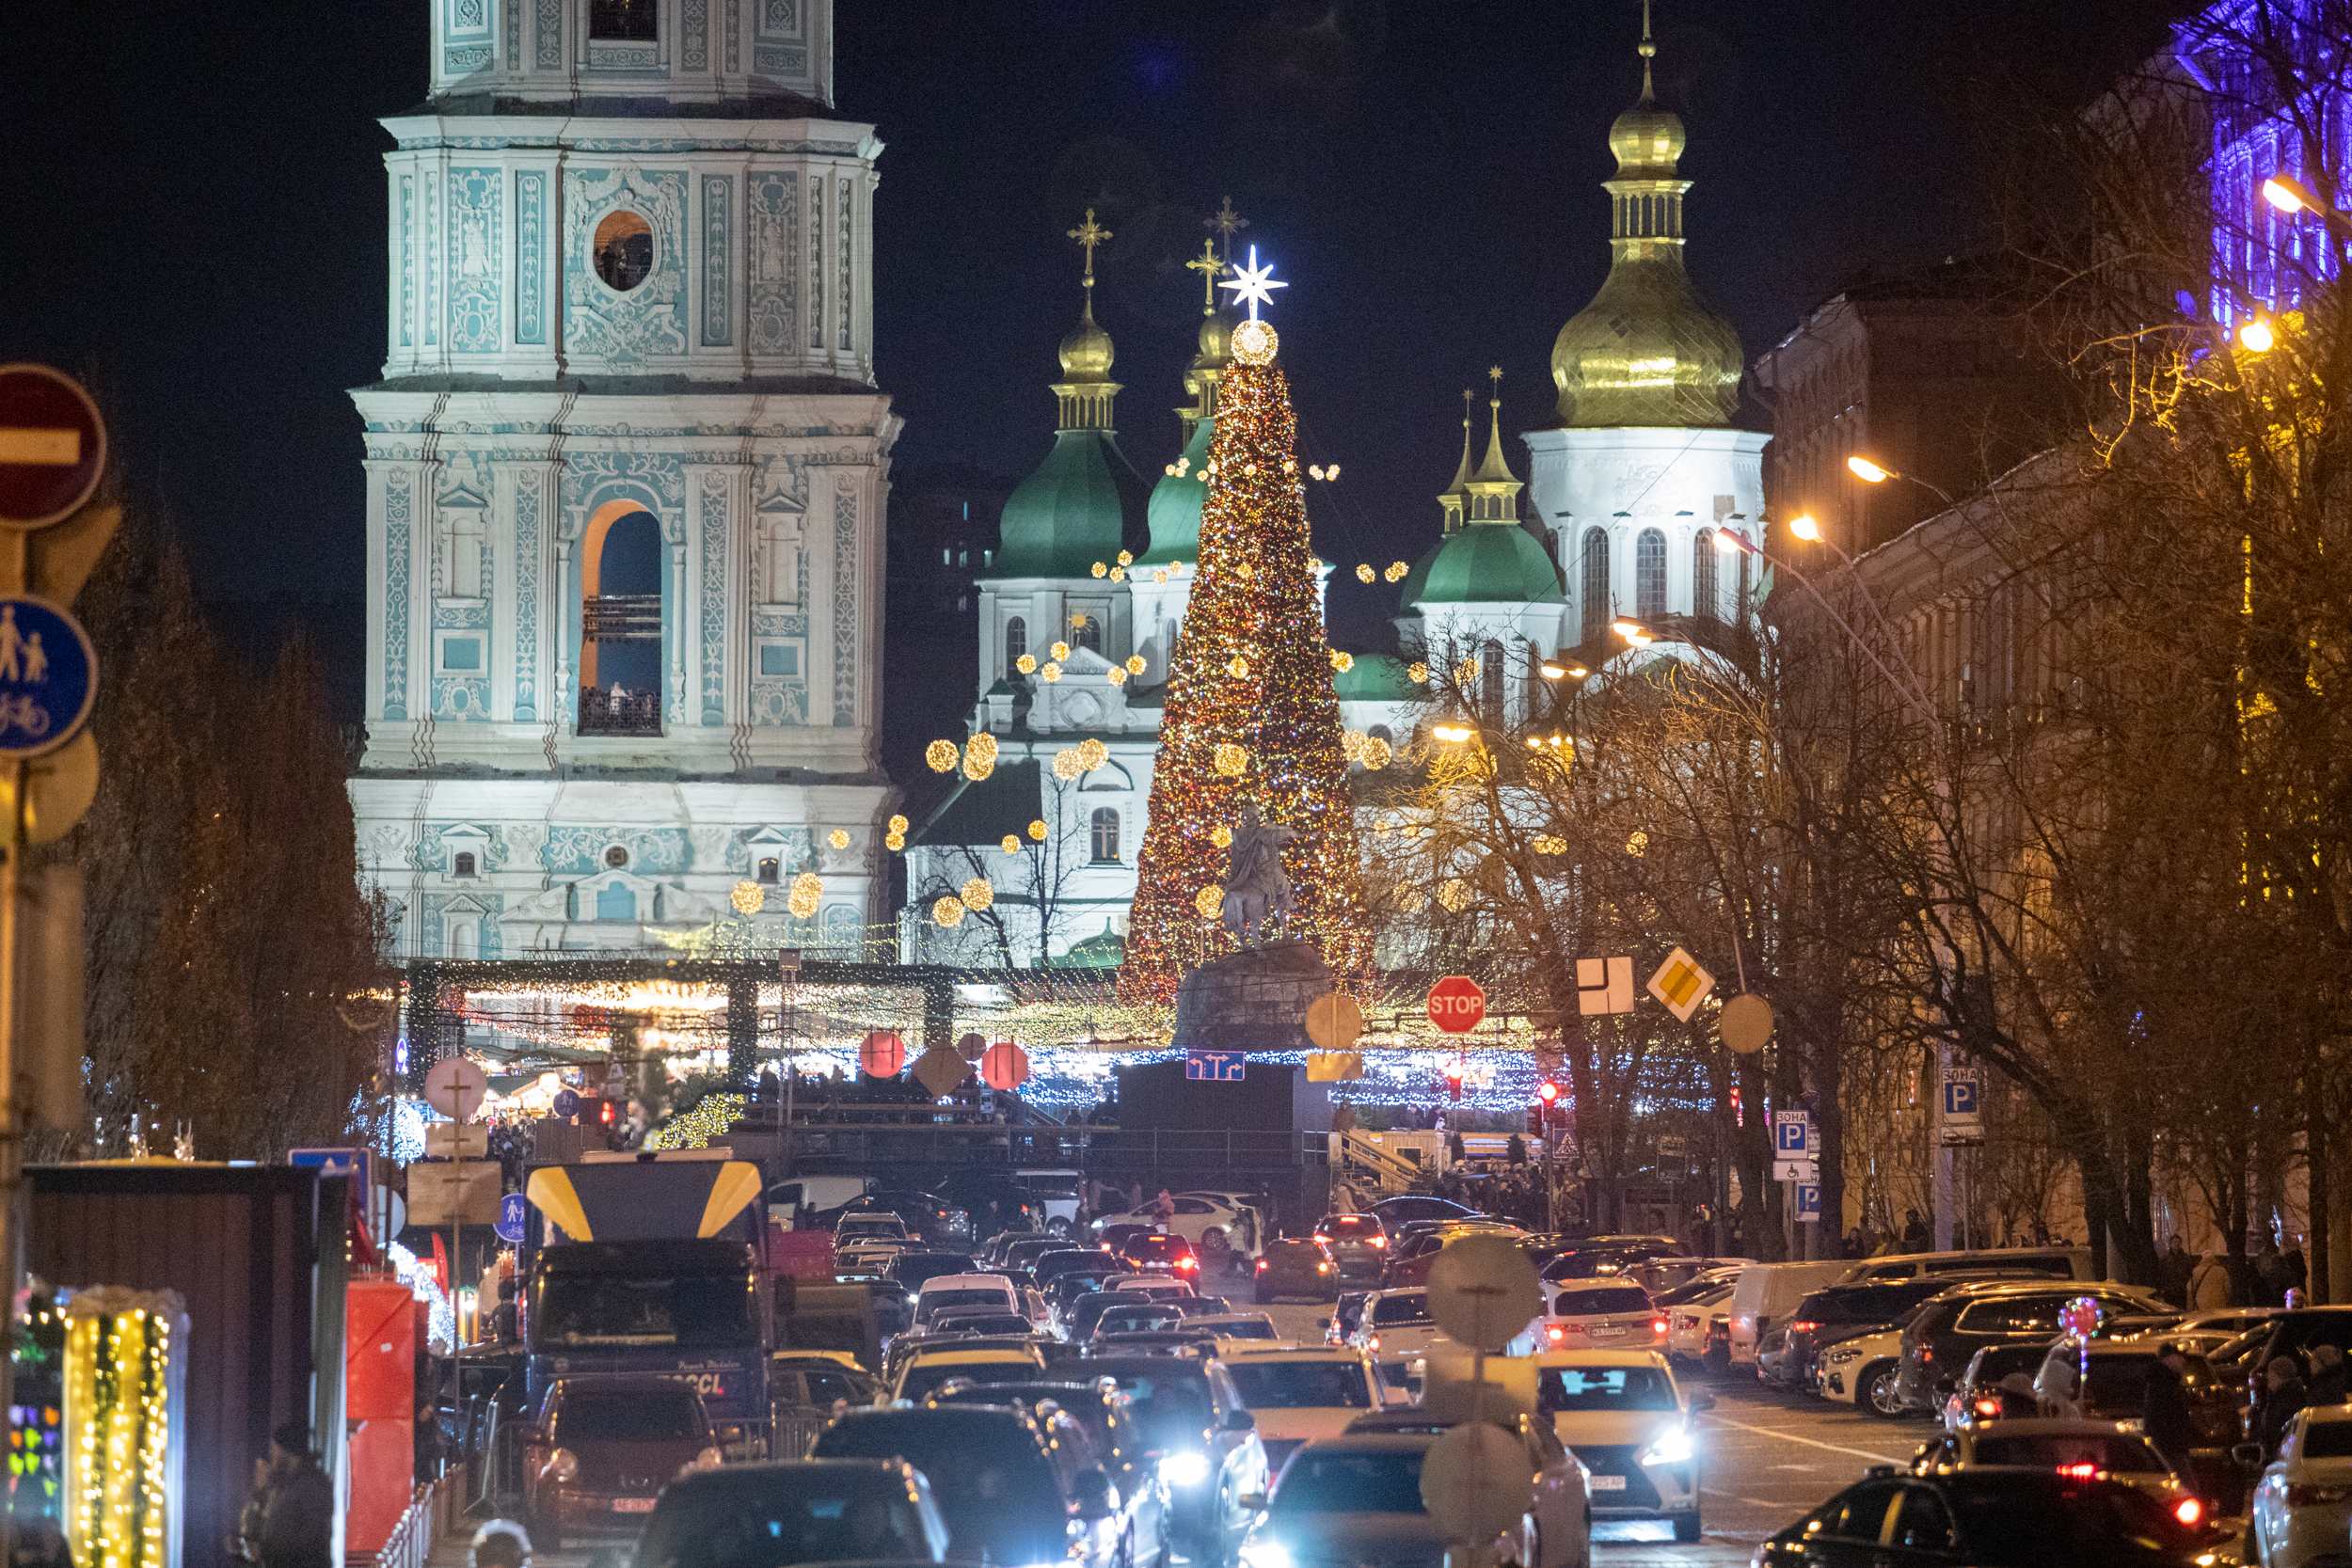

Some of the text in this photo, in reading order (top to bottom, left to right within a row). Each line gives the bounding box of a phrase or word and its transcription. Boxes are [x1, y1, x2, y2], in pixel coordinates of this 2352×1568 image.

[1430, 995, 1483, 1014] STOP
[1943, 1069, 1978, 1081] ЗОНА
[1952, 1085, 1970, 1111] P
[1777, 1113, 1806, 1122] ЗОНА
[1786, 1124, 1802, 1148] P
[1804, 1187, 1819, 1211] P
